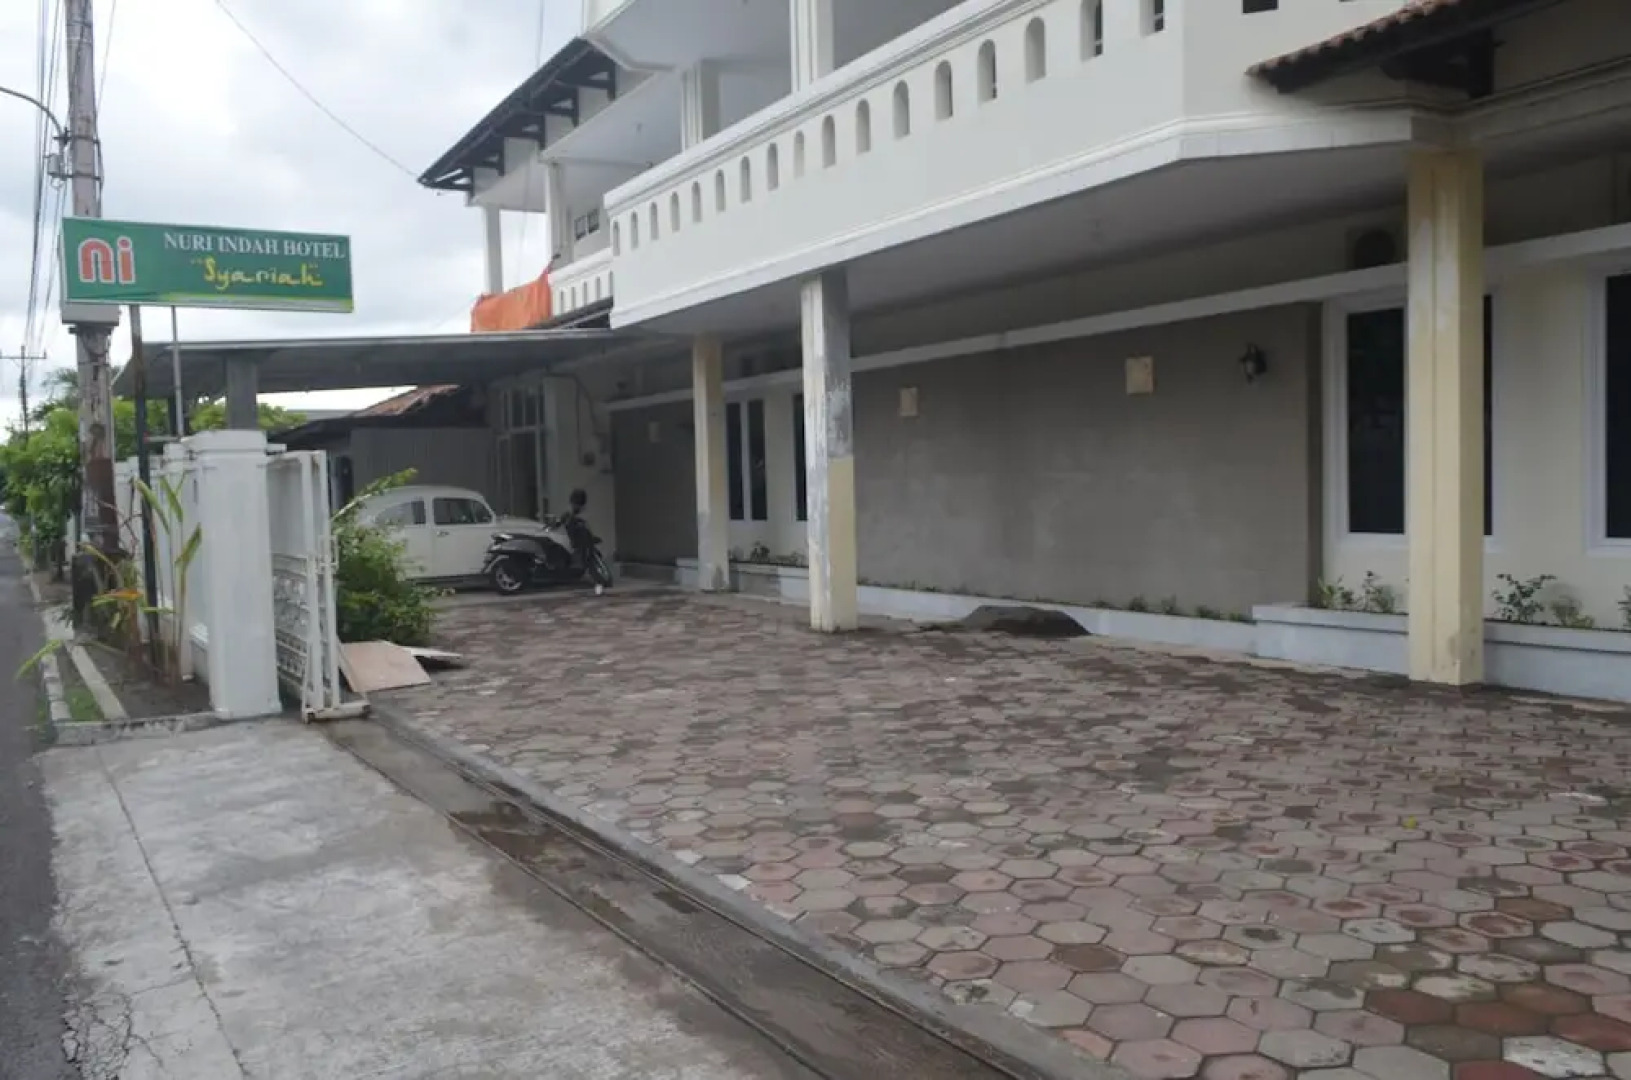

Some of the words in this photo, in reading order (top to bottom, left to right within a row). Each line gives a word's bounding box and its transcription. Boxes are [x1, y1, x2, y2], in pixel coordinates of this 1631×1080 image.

[163, 232, 213, 251] NURI
[219, 236, 278, 255] INDAH
[283, 240, 346, 259] HOTEL
